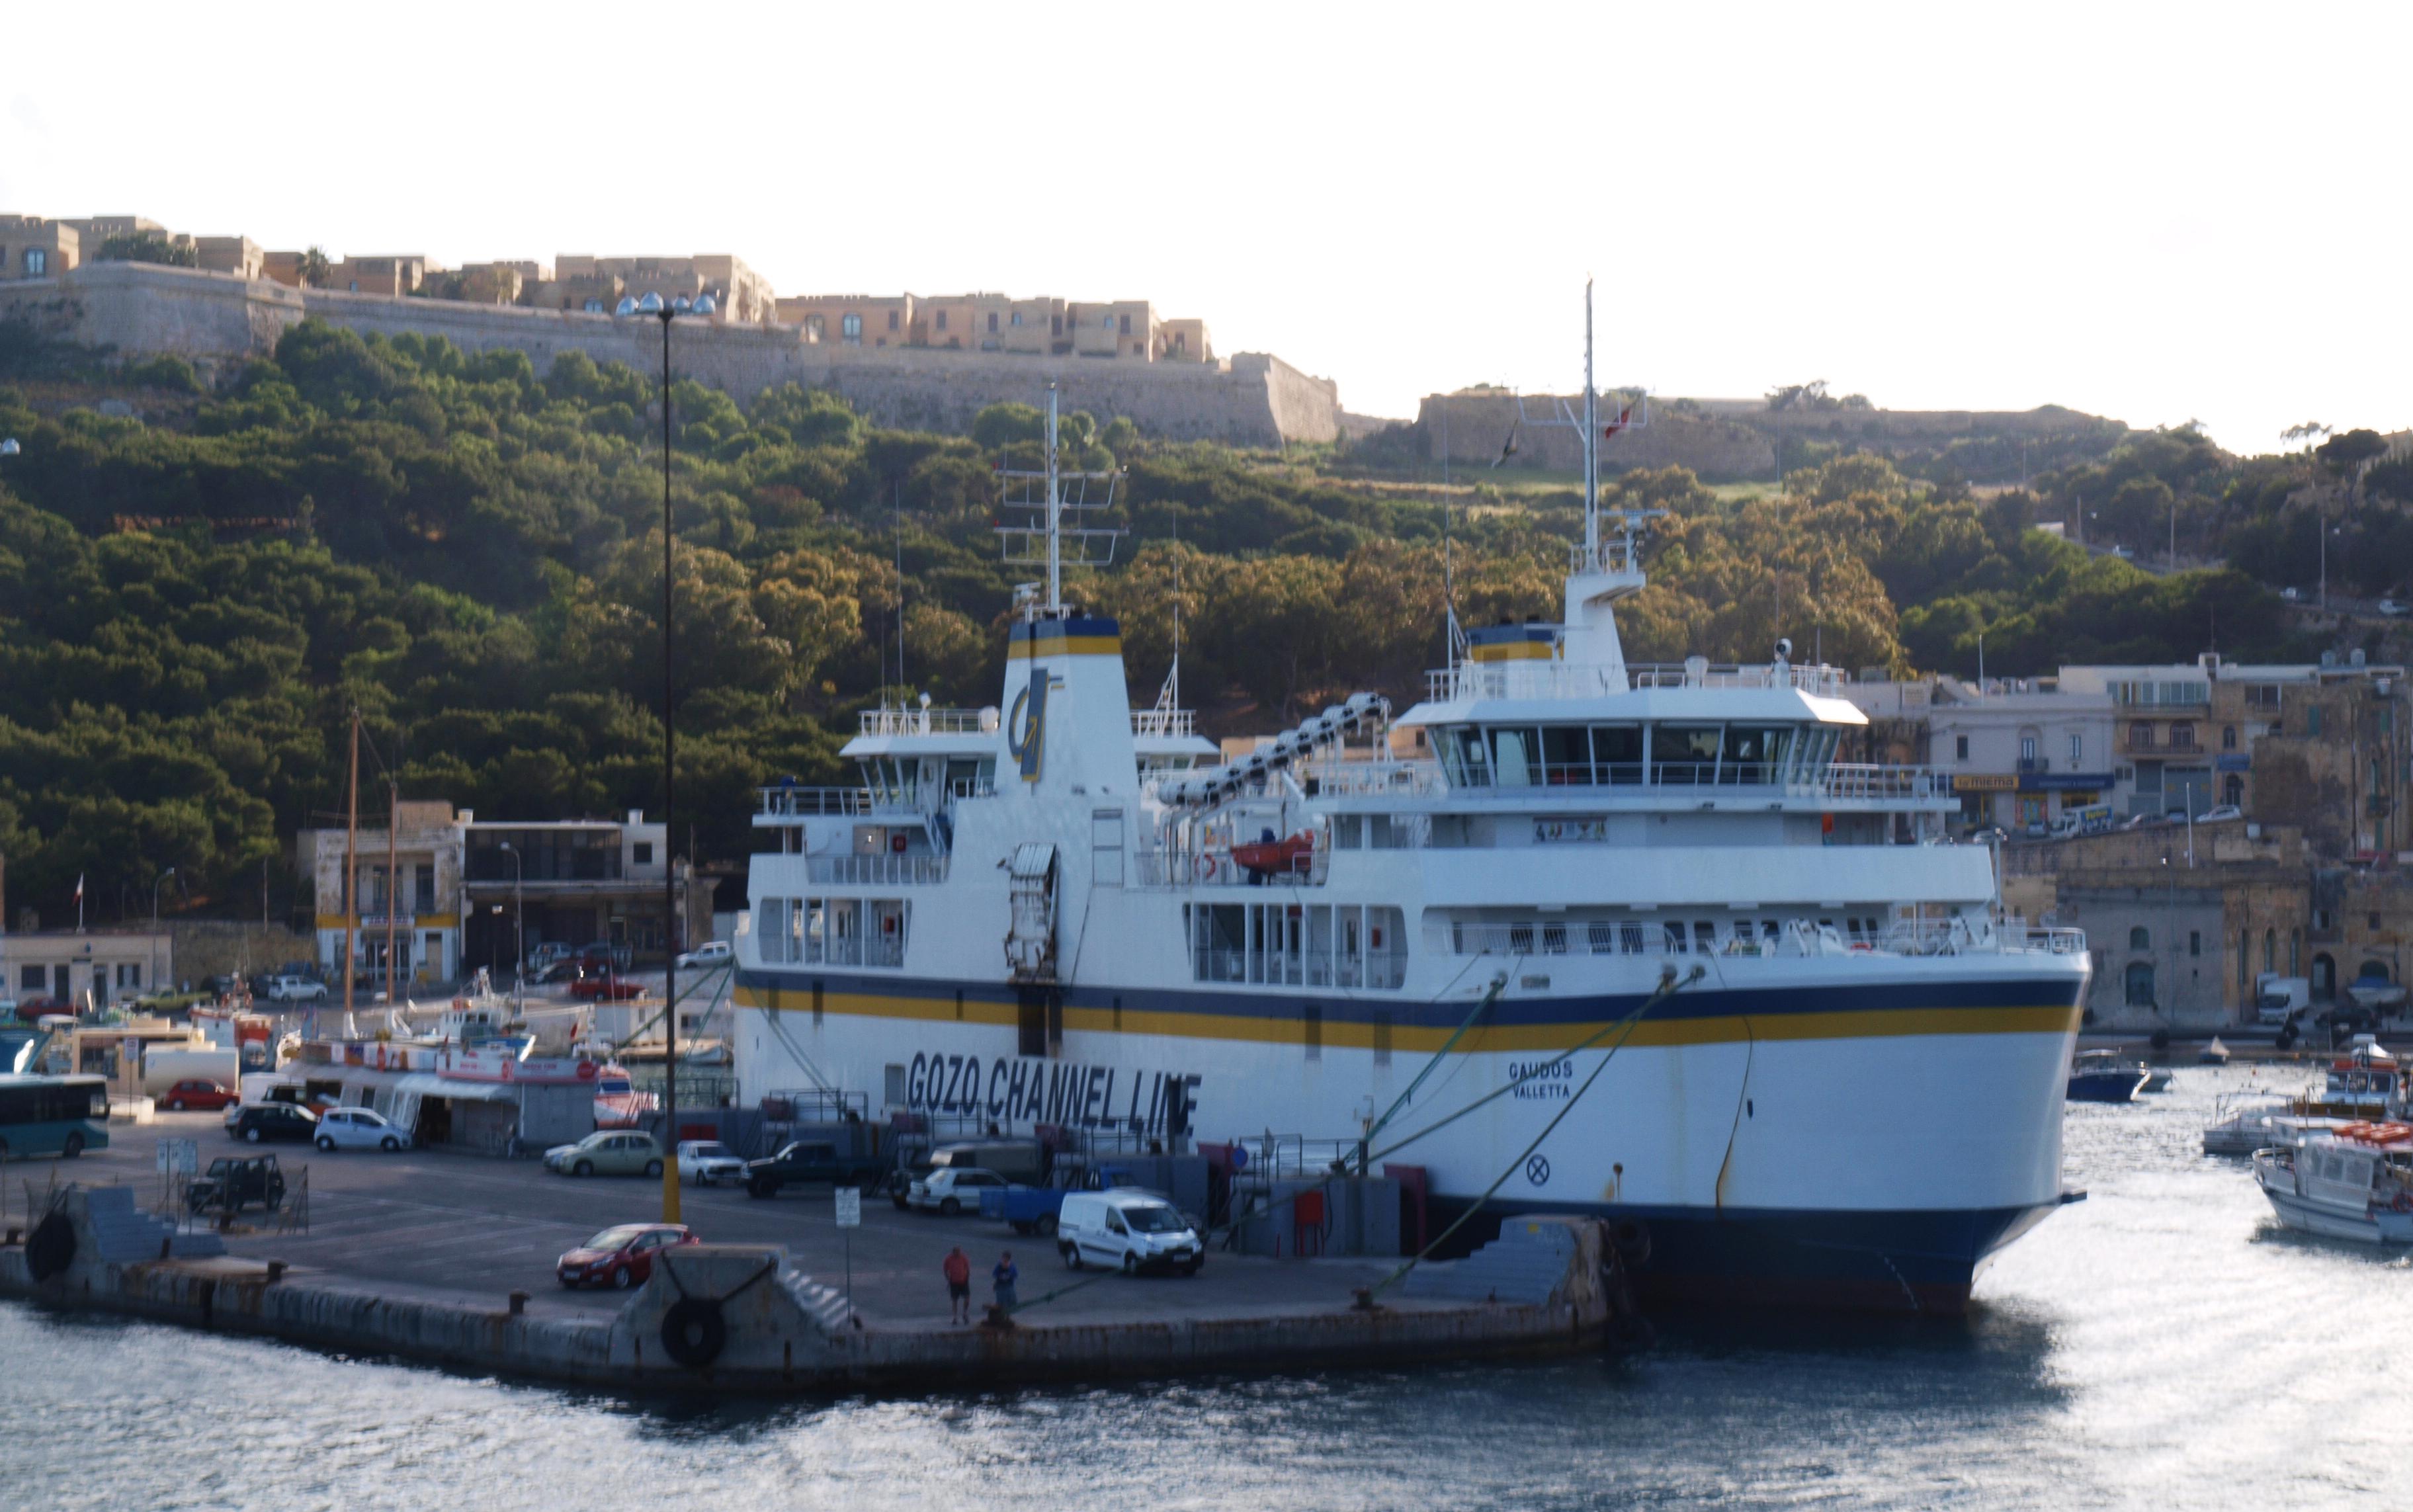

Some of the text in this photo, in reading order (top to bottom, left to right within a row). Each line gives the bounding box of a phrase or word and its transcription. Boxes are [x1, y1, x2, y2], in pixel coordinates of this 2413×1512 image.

[1509, 1061, 1572, 1080] GAUDOS
[908, 1051, 1202, 1137] GOZO CHANNEL LINE
[1513, 1083, 1570, 1099] VALLETTA
